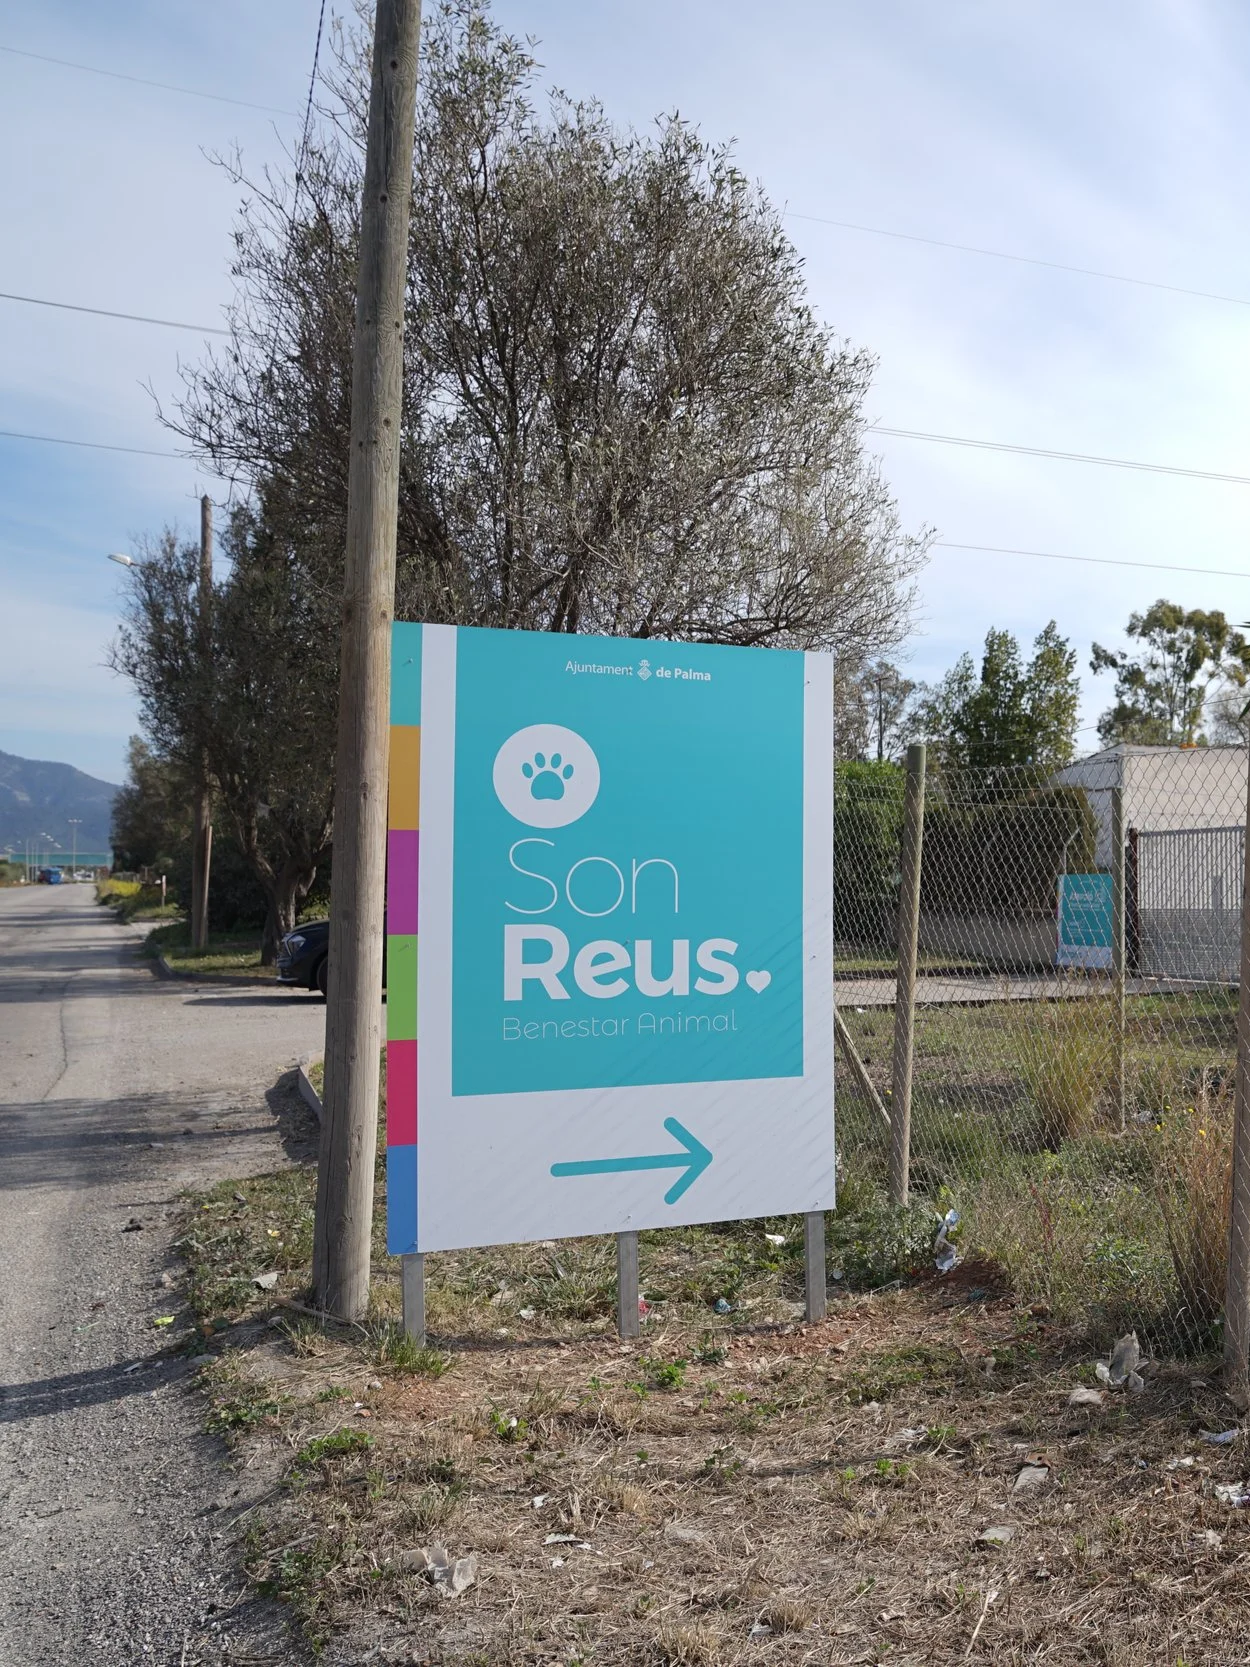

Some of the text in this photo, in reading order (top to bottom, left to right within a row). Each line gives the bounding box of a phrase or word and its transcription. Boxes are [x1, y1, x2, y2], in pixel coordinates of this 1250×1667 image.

[565, 660, 711, 681] Ajuntament de Palma
[504, 837, 679, 917] Son
[503, 923, 740, 1001] Reus
[503, 1008, 738, 1041] Benestar Animal
